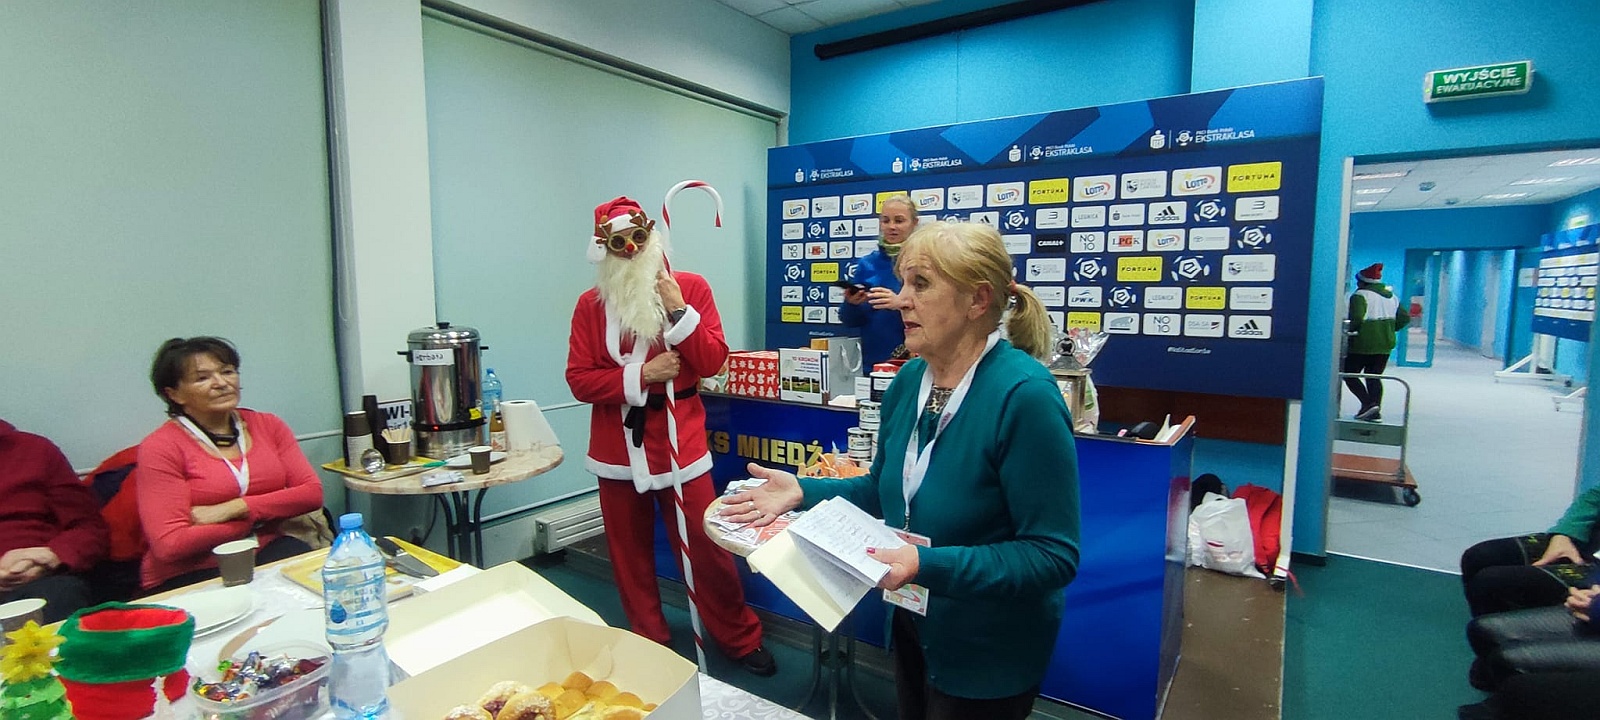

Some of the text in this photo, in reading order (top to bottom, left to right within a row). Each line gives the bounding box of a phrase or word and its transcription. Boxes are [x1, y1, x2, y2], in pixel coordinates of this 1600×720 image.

[1443, 67, 1517, 84] WYJŚCIE
[1436, 77, 1522, 94] EWAKUACYJNE
[1195, 129, 1255, 143] EKSTRAKLASA
[1045, 146, 1093, 157] EKSTRAKLASA
[922, 159, 962, 169] EKSTRAKLASA
[1232, 173, 1275, 181] FORTUNA
[1185, 177, 1208, 189] LOTTO
[1085, 185, 1105, 196] LOTTO
[997, 191, 1015, 201] LOTTO
[851, 202, 865, 211] LOTTO
[919, 197, 935, 206] LOTTO
[1079, 234, 1095, 242] NO
[1112, 236, 1140, 246] LPGK
[1157, 236, 1176, 246] LOTTO
[787, 244, 797, 252] NO
[1084, 242, 1095, 251] 10
[1153, 315, 1171, 324] NO
[1158, 324, 1171, 333] 10
